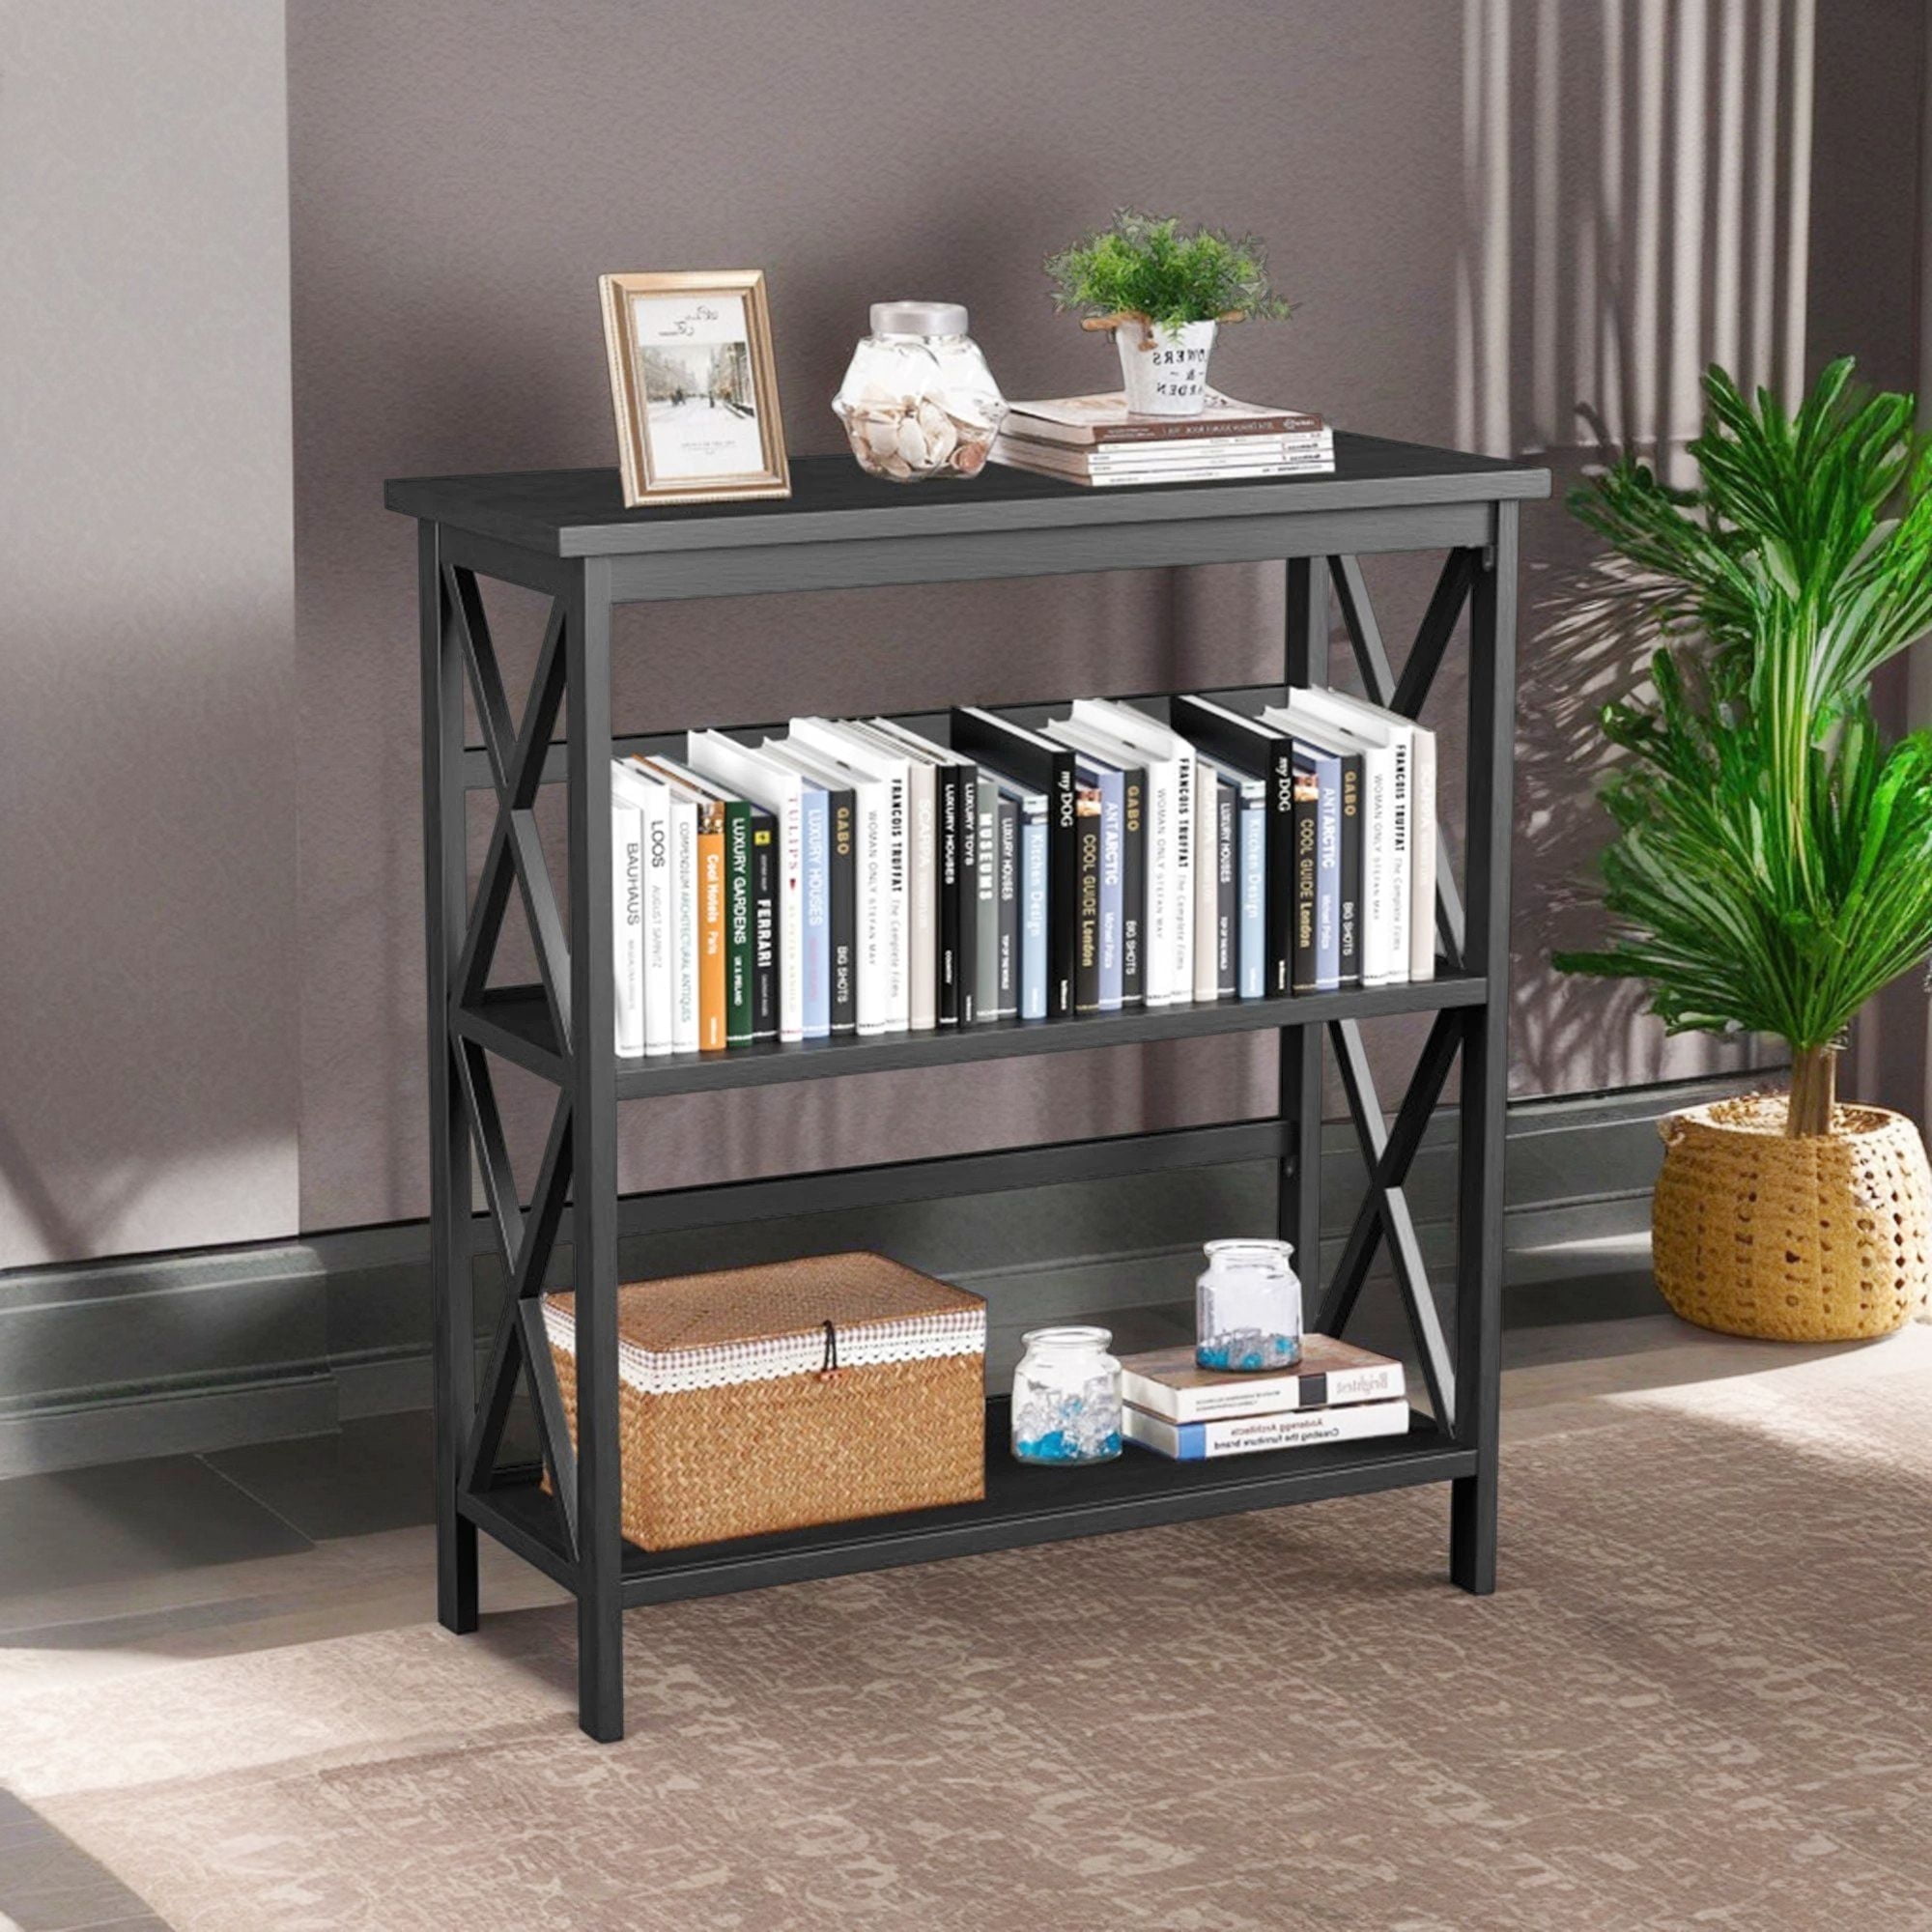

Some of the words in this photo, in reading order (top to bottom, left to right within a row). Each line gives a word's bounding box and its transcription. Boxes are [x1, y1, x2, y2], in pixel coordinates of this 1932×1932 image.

[1178, 757, 1190, 814] FRANCOIS
[1278, 778, 1291, 812] DOG
[1344, 771, 1357, 816] GABO
[1394, 744, 1406, 800] FRANCOIS
[891, 778, 902, 838] FRANCOIS
[945, 783, 955, 830] LUXURY
[964, 783, 975, 829] LUXURY
[1061, 792, 1073, 827] DOG
[1127, 785, 1140, 832] GABO
[1220, 802, 1232, 840] LUXURY
[651, 820, 666, 867] LOOS
[733, 817, 746, 872] LUXURY
[788, 796, 798, 871] TULIPS
[809, 809, 823, 865] LUXURY
[837, 807, 850, 855] GABO
[1002, 817, 1013, 857] LUXURY
[1083, 834, 1096, 871] COOL
[1300, 818, 1314, 856] COOL
[679, 821, 691, 889] COMPENDIUM
[706, 854, 719, 881] Cool
[945, 834, 954, 885] HOUSES
[979, 812, 993, 900] MUSEUMS
[1030, 833, 1043, 886] Kitchen
[1220, 843, 1231, 884] HOUSES
[1300, 859, 1314, 898] GUIDE
[627, 842, 639, 925] BAUHAUS
[706, 883, 719, 923] Hotels
[809, 868, 823, 926] HOUSES
[1082, 875, 1095, 916] GUIDE
[733, 875, 746, 945] GARDENS
[757, 898, 772, 967] FERRARI
[1299, 902, 1313, 948] London
[1081, 920, 1094, 967] London
[837, 966, 849, 1004] SHOTS
